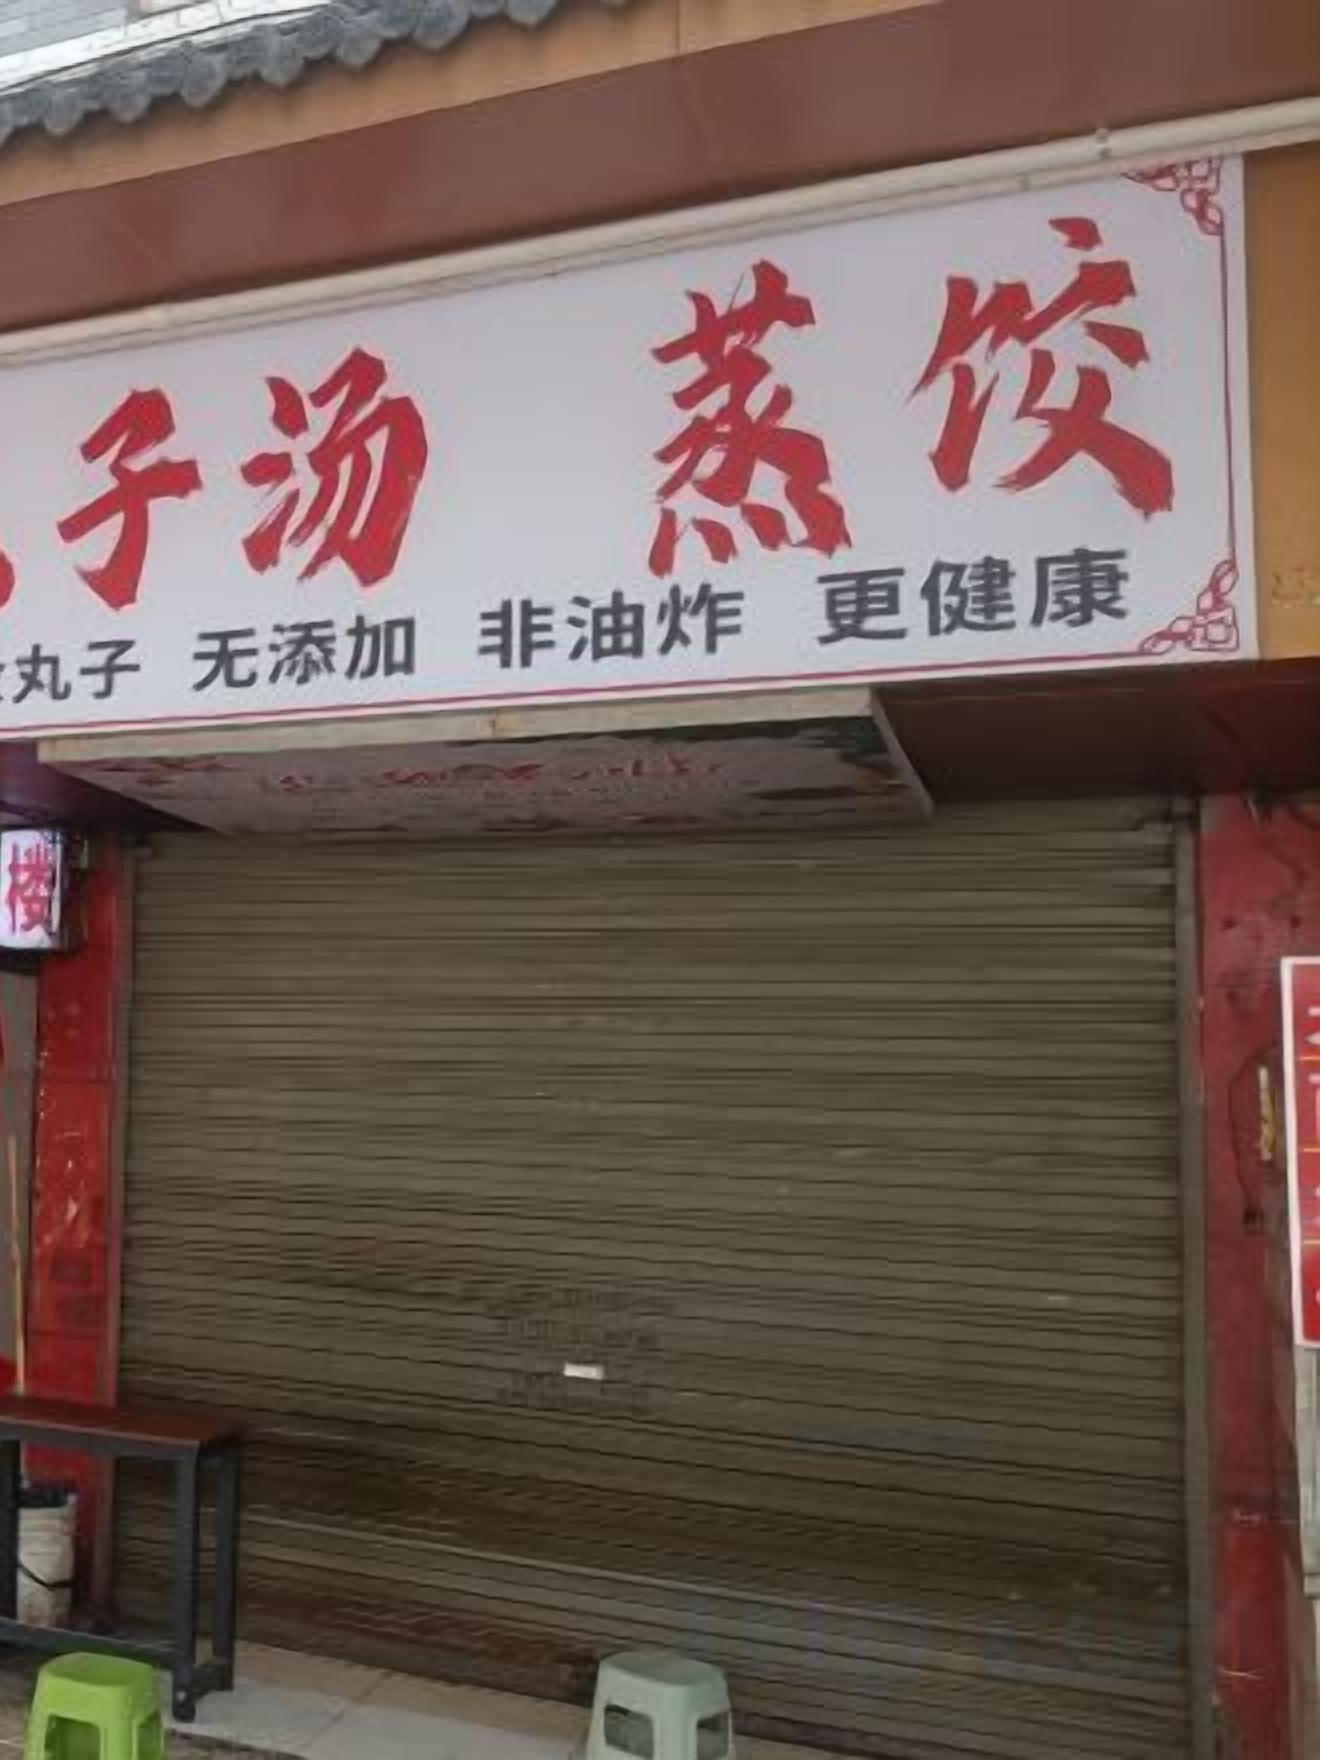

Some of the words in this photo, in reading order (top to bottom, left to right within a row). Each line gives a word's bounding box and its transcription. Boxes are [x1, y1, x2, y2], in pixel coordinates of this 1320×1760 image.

[649, 217, 1175, 576] 蒸饺
[193, 615, 416, 691] 无添加
[478, 583, 744, 669] 非油炸
[817, 546, 1129, 645] 更健康
